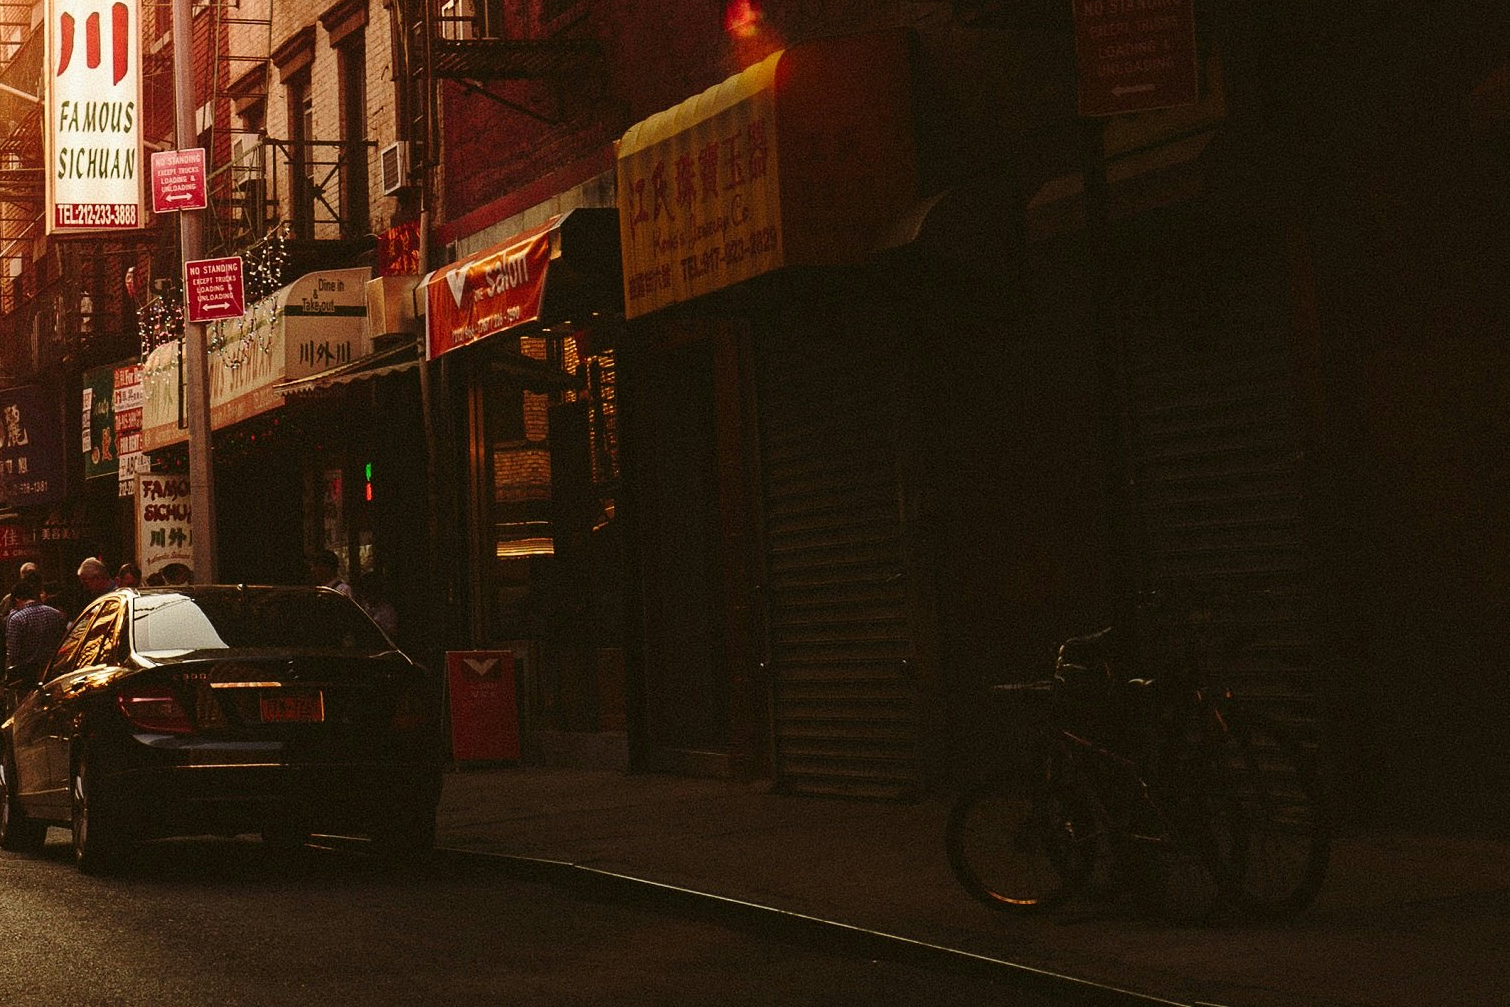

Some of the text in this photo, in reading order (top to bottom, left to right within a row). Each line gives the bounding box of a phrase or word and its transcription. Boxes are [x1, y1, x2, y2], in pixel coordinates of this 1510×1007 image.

[60, 100, 135, 133] FAMOUS
[57, 147, 136, 180] SICHUAN
[156, 155, 201, 167] NO STANDING
[157, 166, 199, 177] EXCEPT TRUCKS
[160, 175, 187, 184] LOADING
[161, 183, 196, 193] UNLOADING
[189, 263, 238, 276] NO STANDING
[192, 275, 237, 286] EXCEPT TRUCKS
[318, 278, 345, 292] Dine in
[196, 285, 225, 294] LOADING
[197, 292, 234, 302] UNLOADING
[299, 340, 351, 368] 川外川
